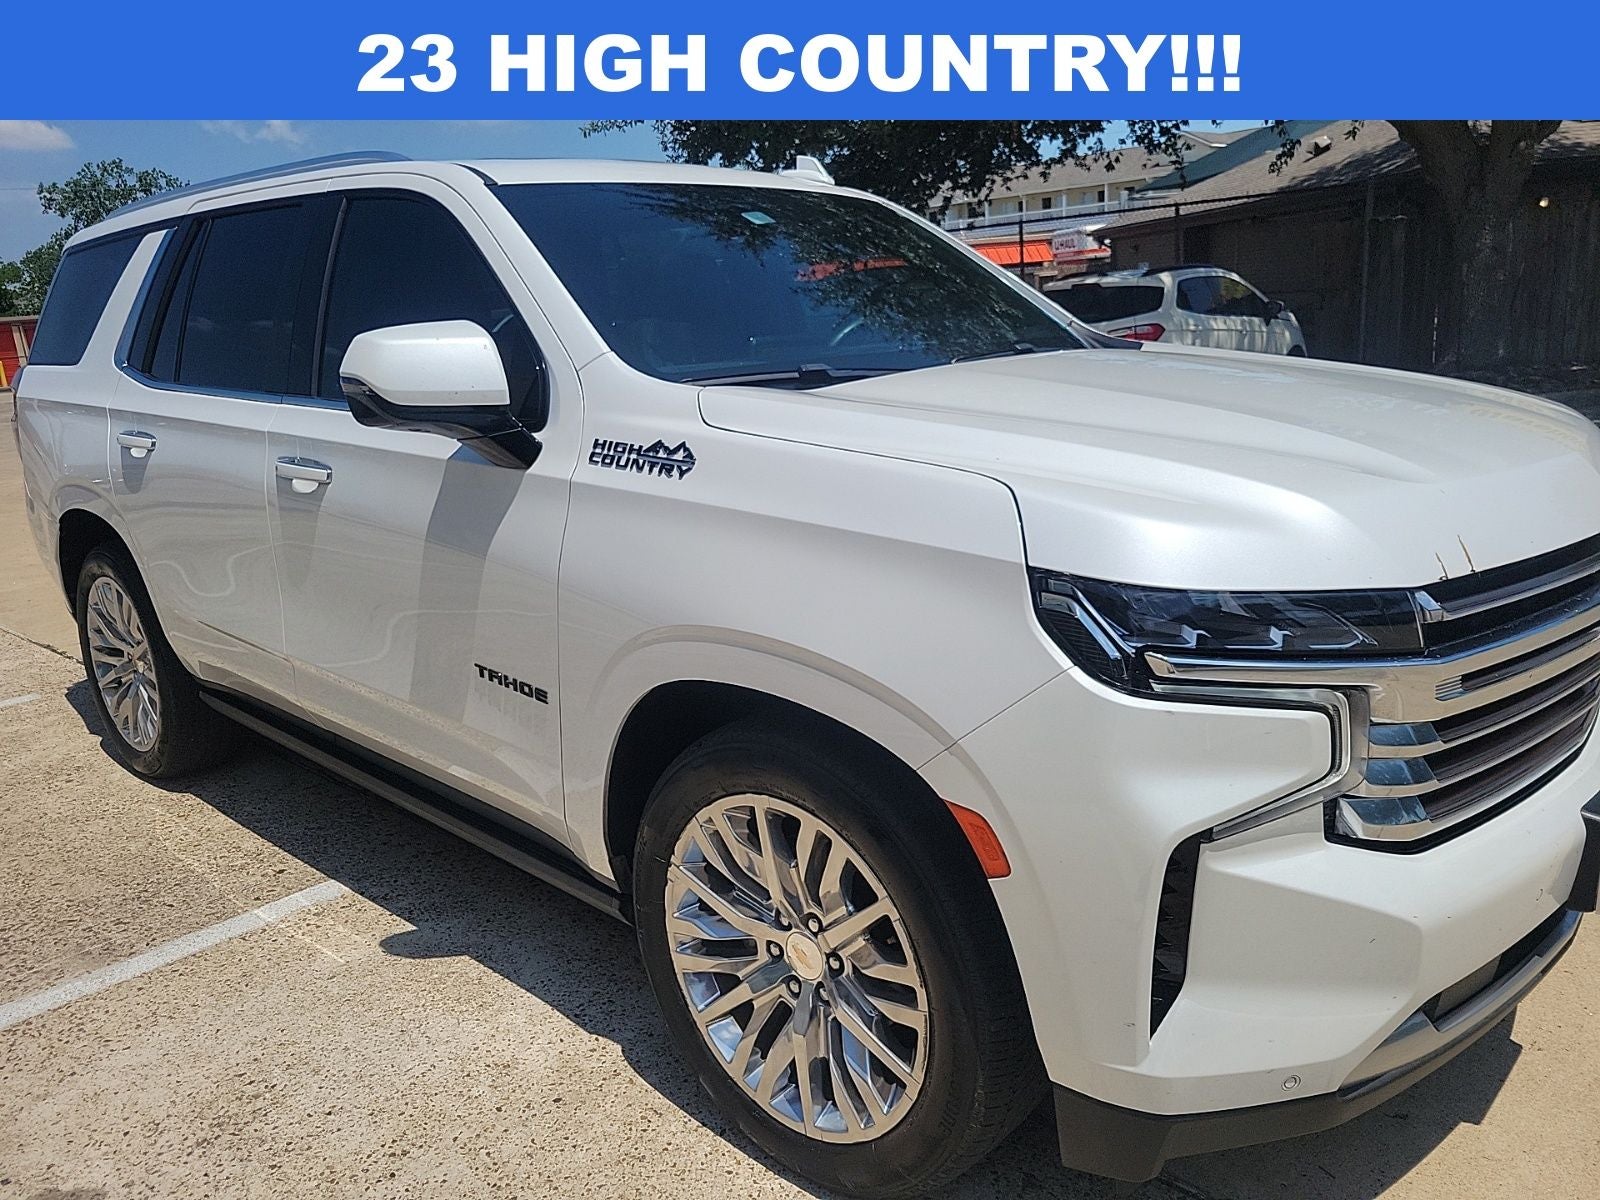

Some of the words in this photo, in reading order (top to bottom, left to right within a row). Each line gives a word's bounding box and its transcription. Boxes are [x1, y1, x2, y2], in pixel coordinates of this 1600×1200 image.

[593, 438, 643, 456] HIGH
[588, 451, 694, 480] COUNTRY
[474, 662, 549, 704] TAHOE
